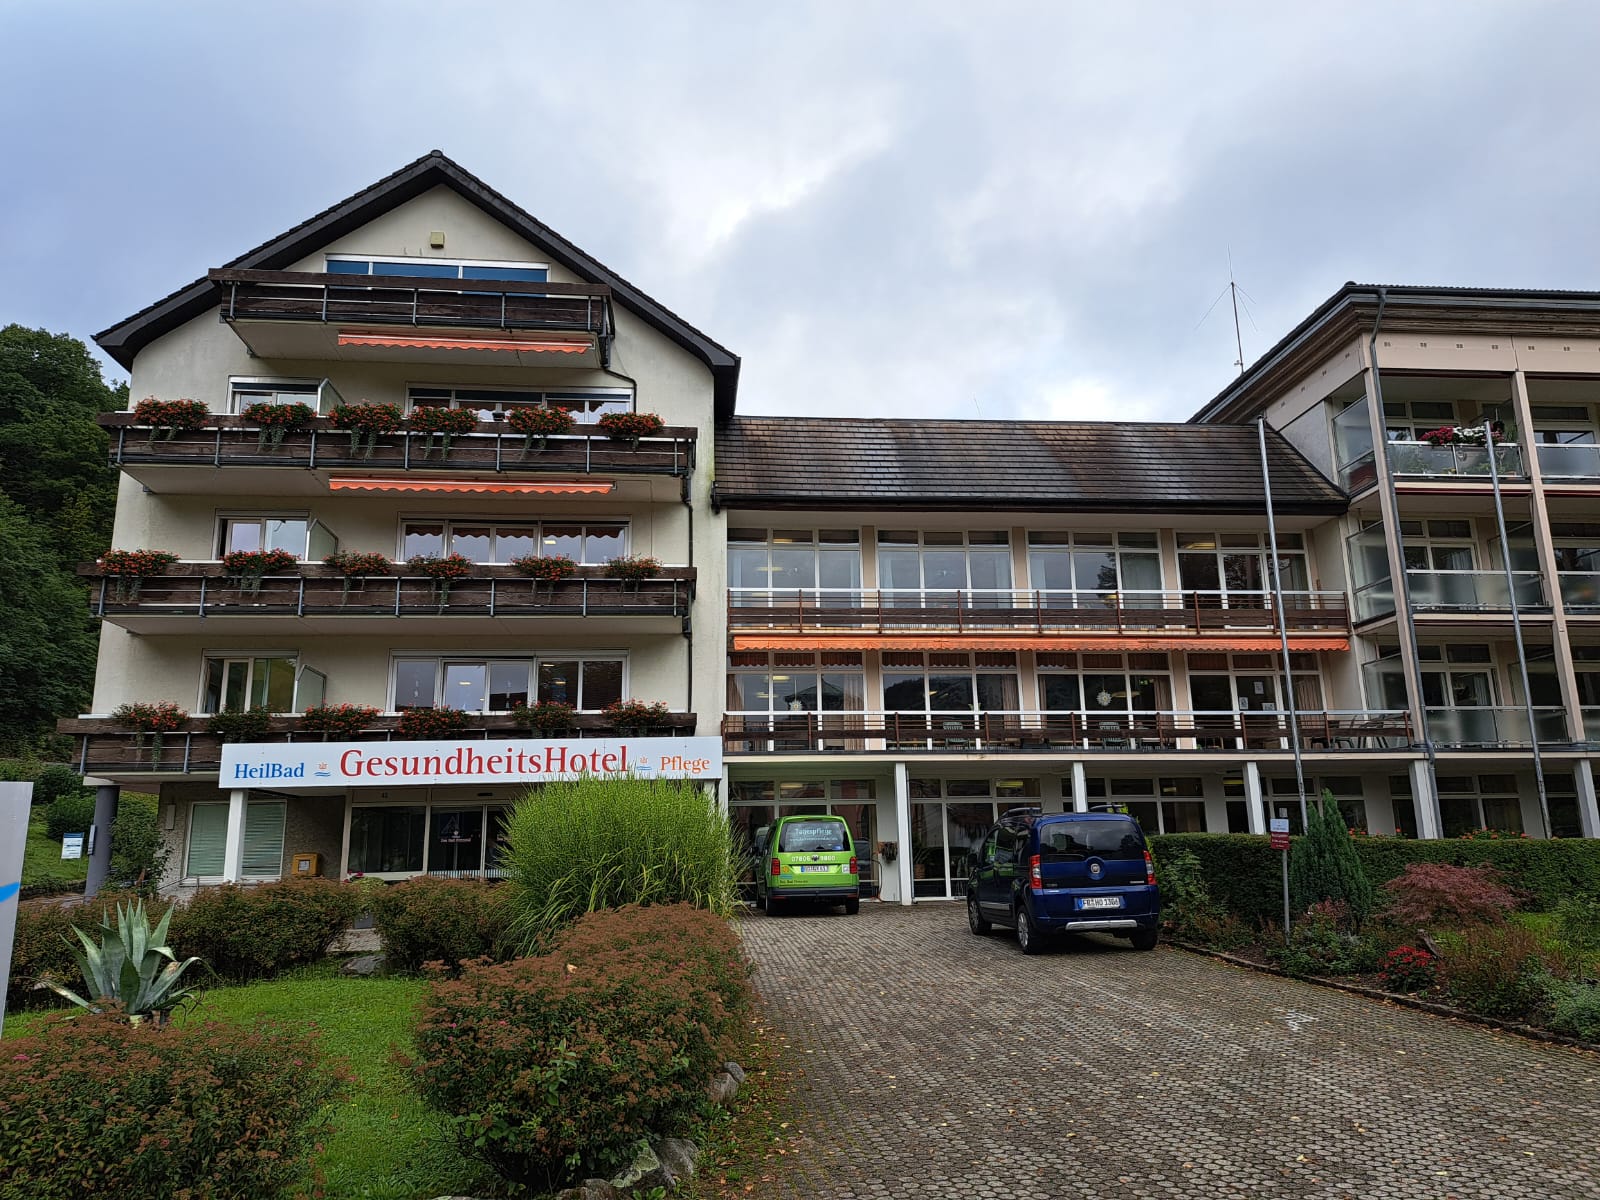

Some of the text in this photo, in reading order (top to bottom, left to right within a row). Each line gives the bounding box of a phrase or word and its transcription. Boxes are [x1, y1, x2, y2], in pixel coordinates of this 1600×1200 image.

[234, 745, 711, 779] HeilBad GesundheitsHotel Pflege
